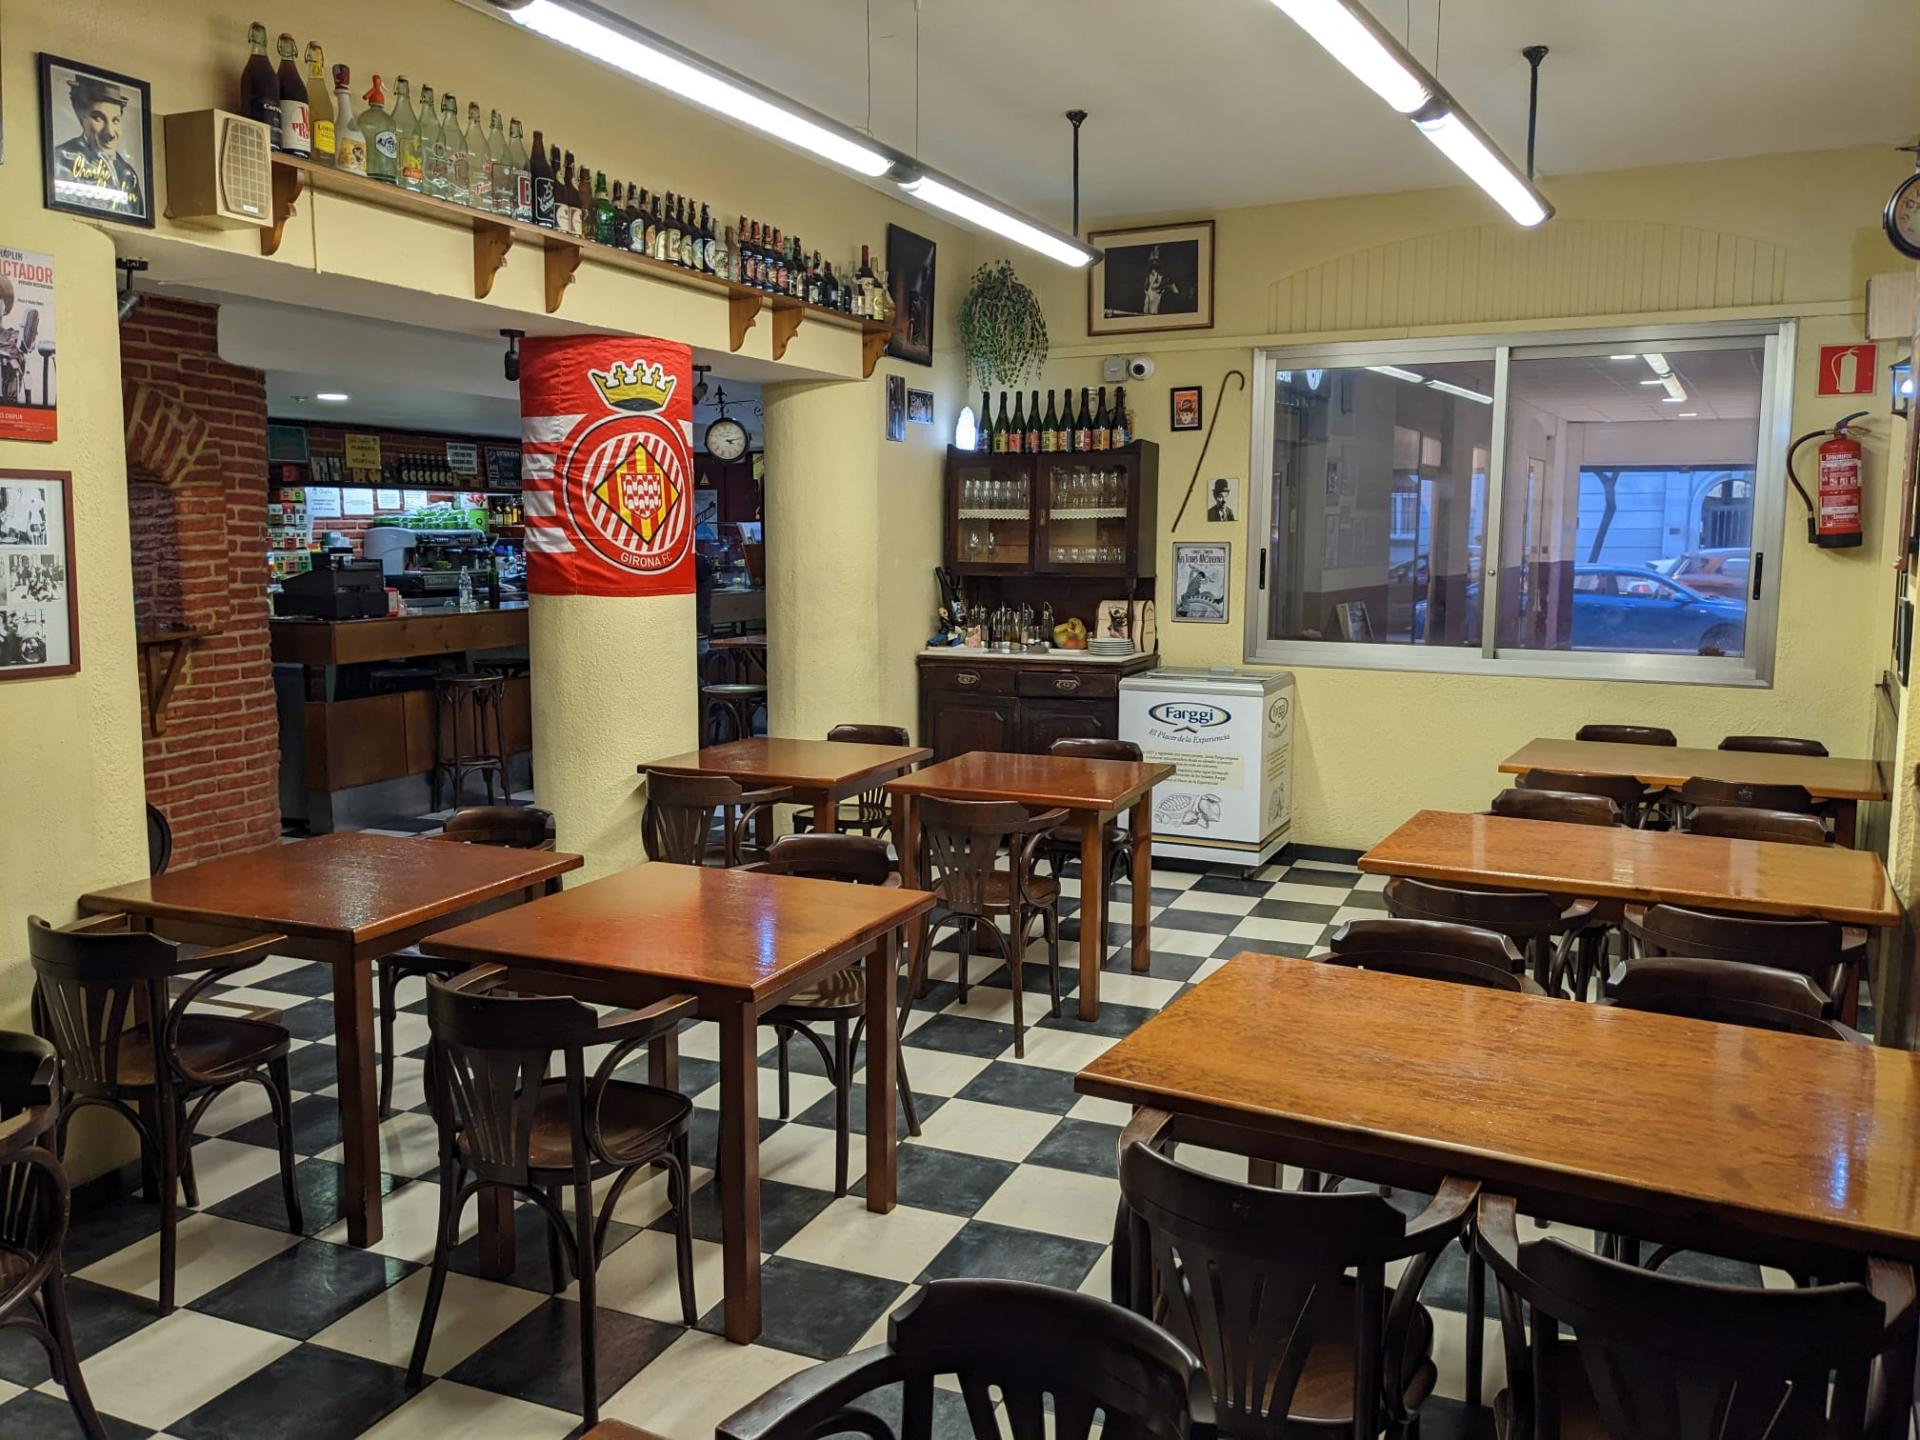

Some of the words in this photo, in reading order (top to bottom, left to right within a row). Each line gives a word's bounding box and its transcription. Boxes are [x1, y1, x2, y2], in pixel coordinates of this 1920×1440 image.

[73, 154, 111, 179] Charlie
[620, 552, 662, 567] GIRONA
[661, 551, 673, 564] FC
[1166, 706, 1214, 724] Farggi
[1149, 728, 1157, 736] El
[1193, 733, 1231, 745] Experiencia
